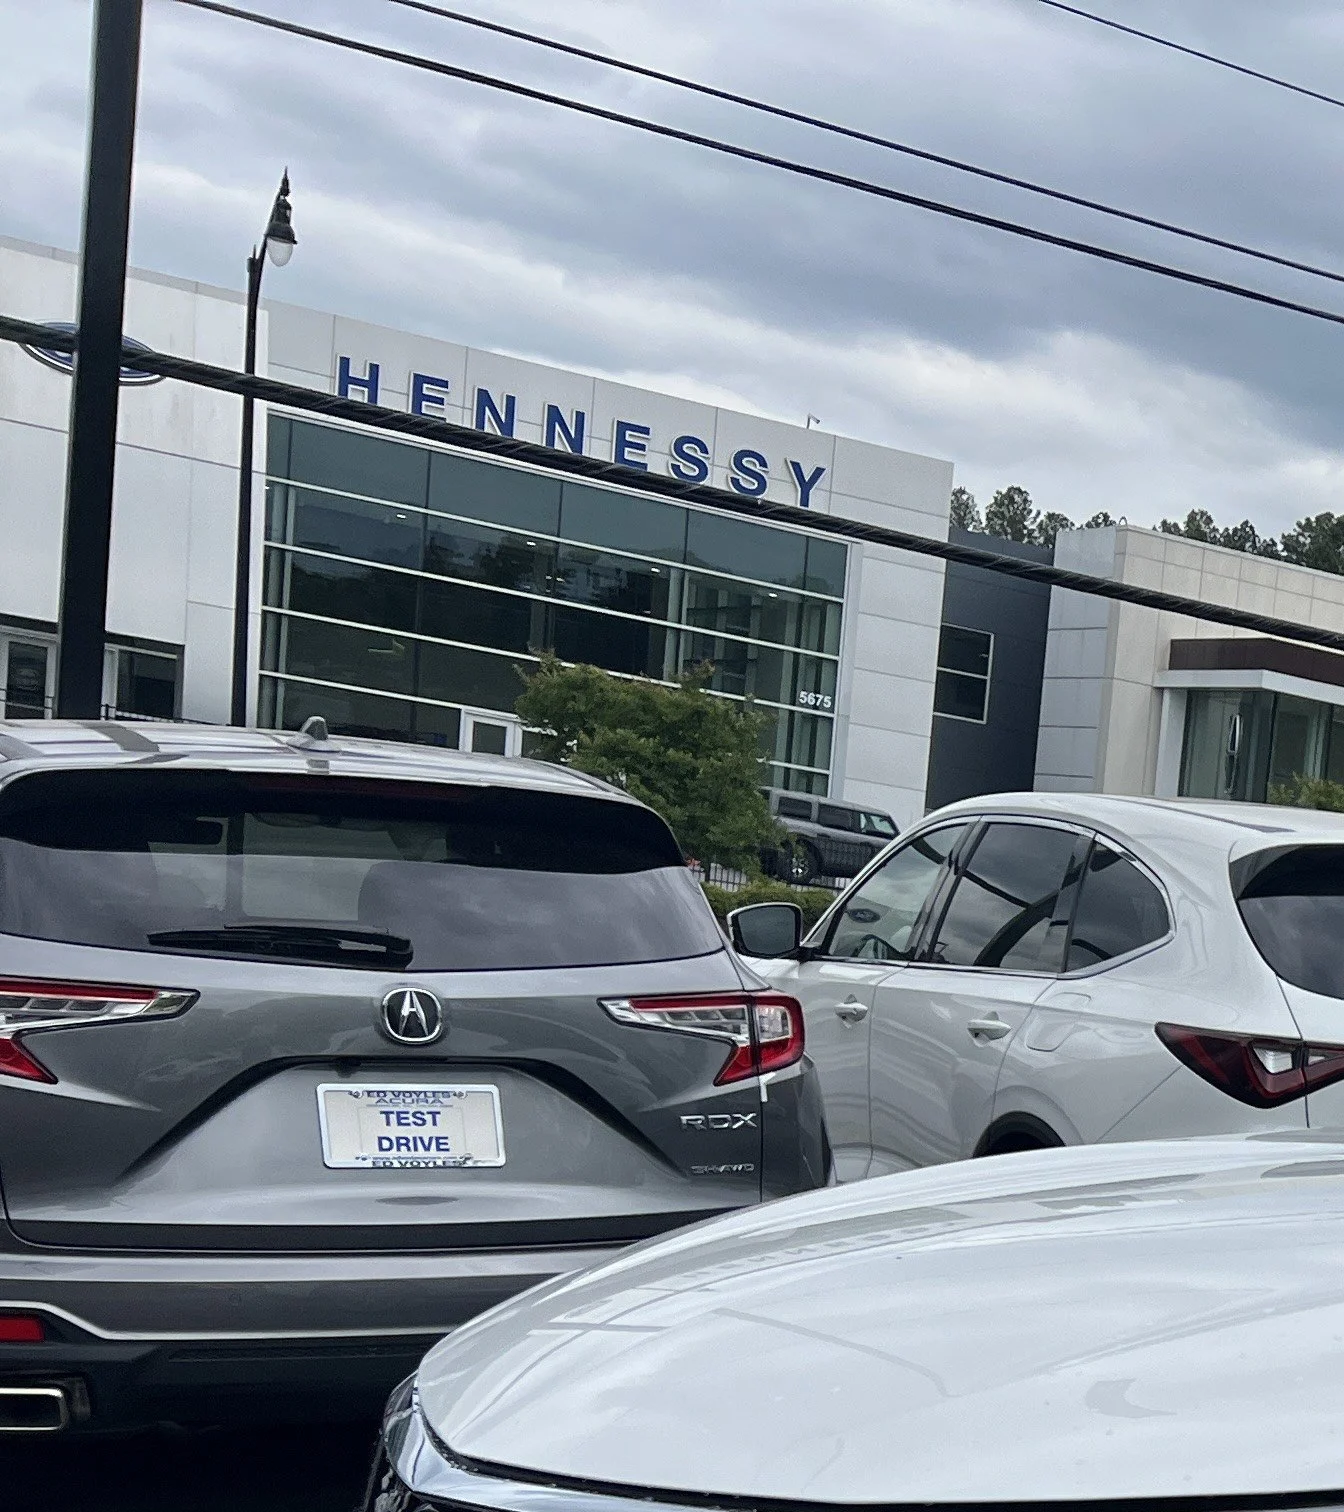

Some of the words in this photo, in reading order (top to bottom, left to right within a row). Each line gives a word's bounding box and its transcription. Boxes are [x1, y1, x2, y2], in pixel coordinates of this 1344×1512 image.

[337, 354, 827, 508] HENNESSY
[799, 690, 832, 708] 5675
[375, 1097, 444, 1105] ACURA
[379, 1110, 442, 1127] TEST
[680, 1112, 757, 1130] RDX
[377, 1135, 450, 1152] DRIVE
